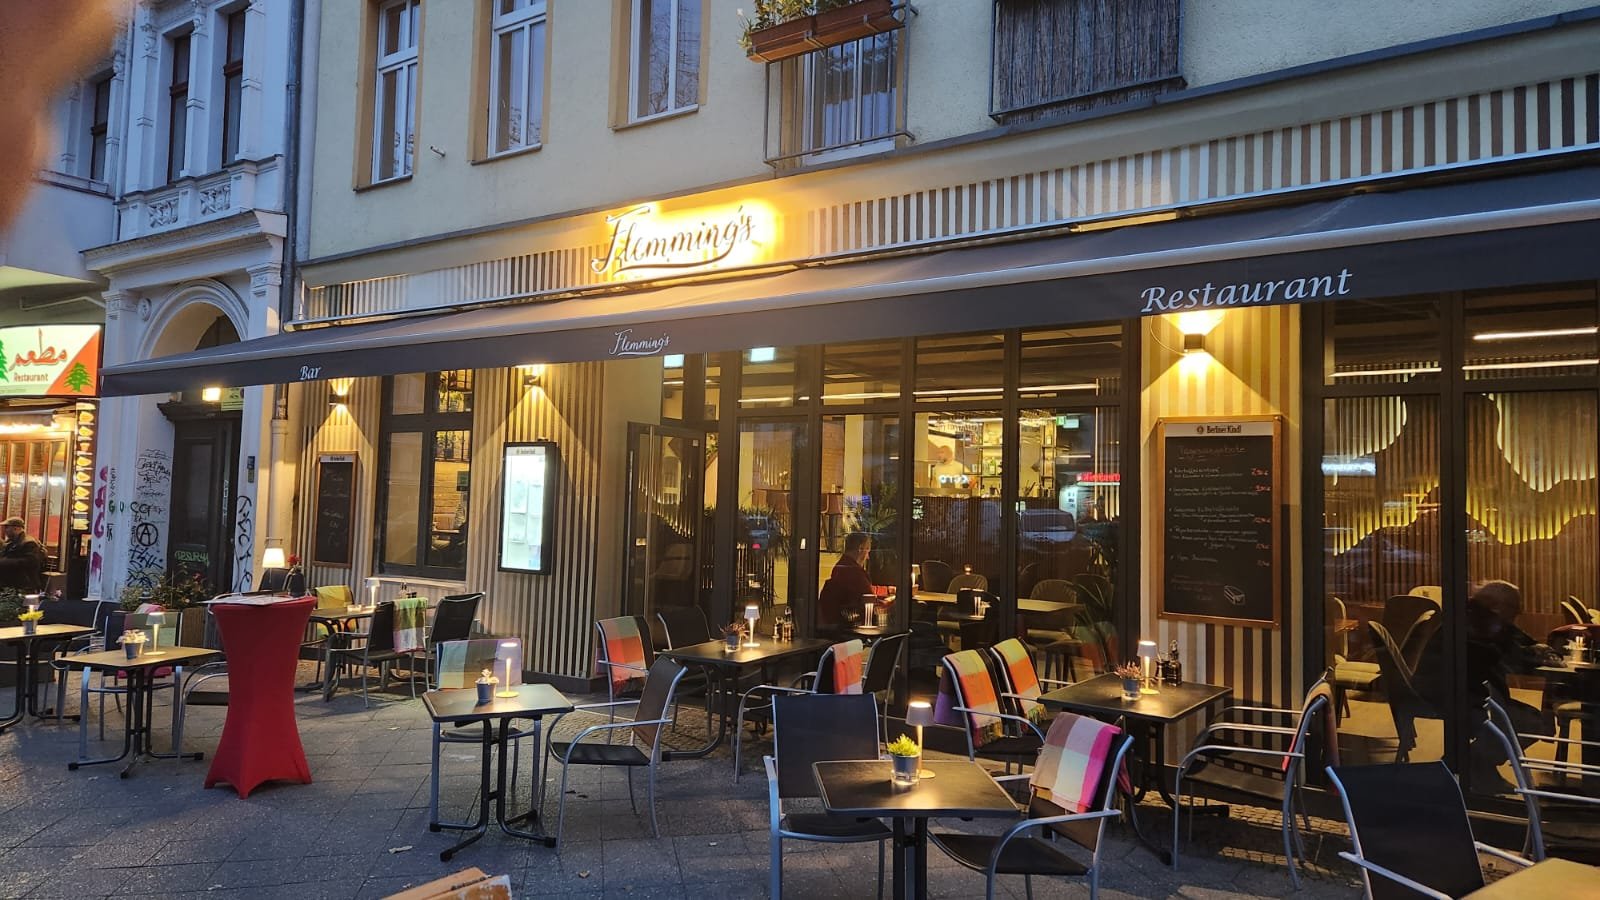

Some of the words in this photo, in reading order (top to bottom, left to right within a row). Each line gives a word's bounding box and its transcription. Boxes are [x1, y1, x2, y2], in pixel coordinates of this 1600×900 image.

[591, 205, 756, 277] Flemming's
[1140, 268, 1353, 313] Restaurant
[608, 328, 671, 356] Flemming's
[13, 372, 49, 382] Restaurant
[300, 365, 322, 381] Bar
